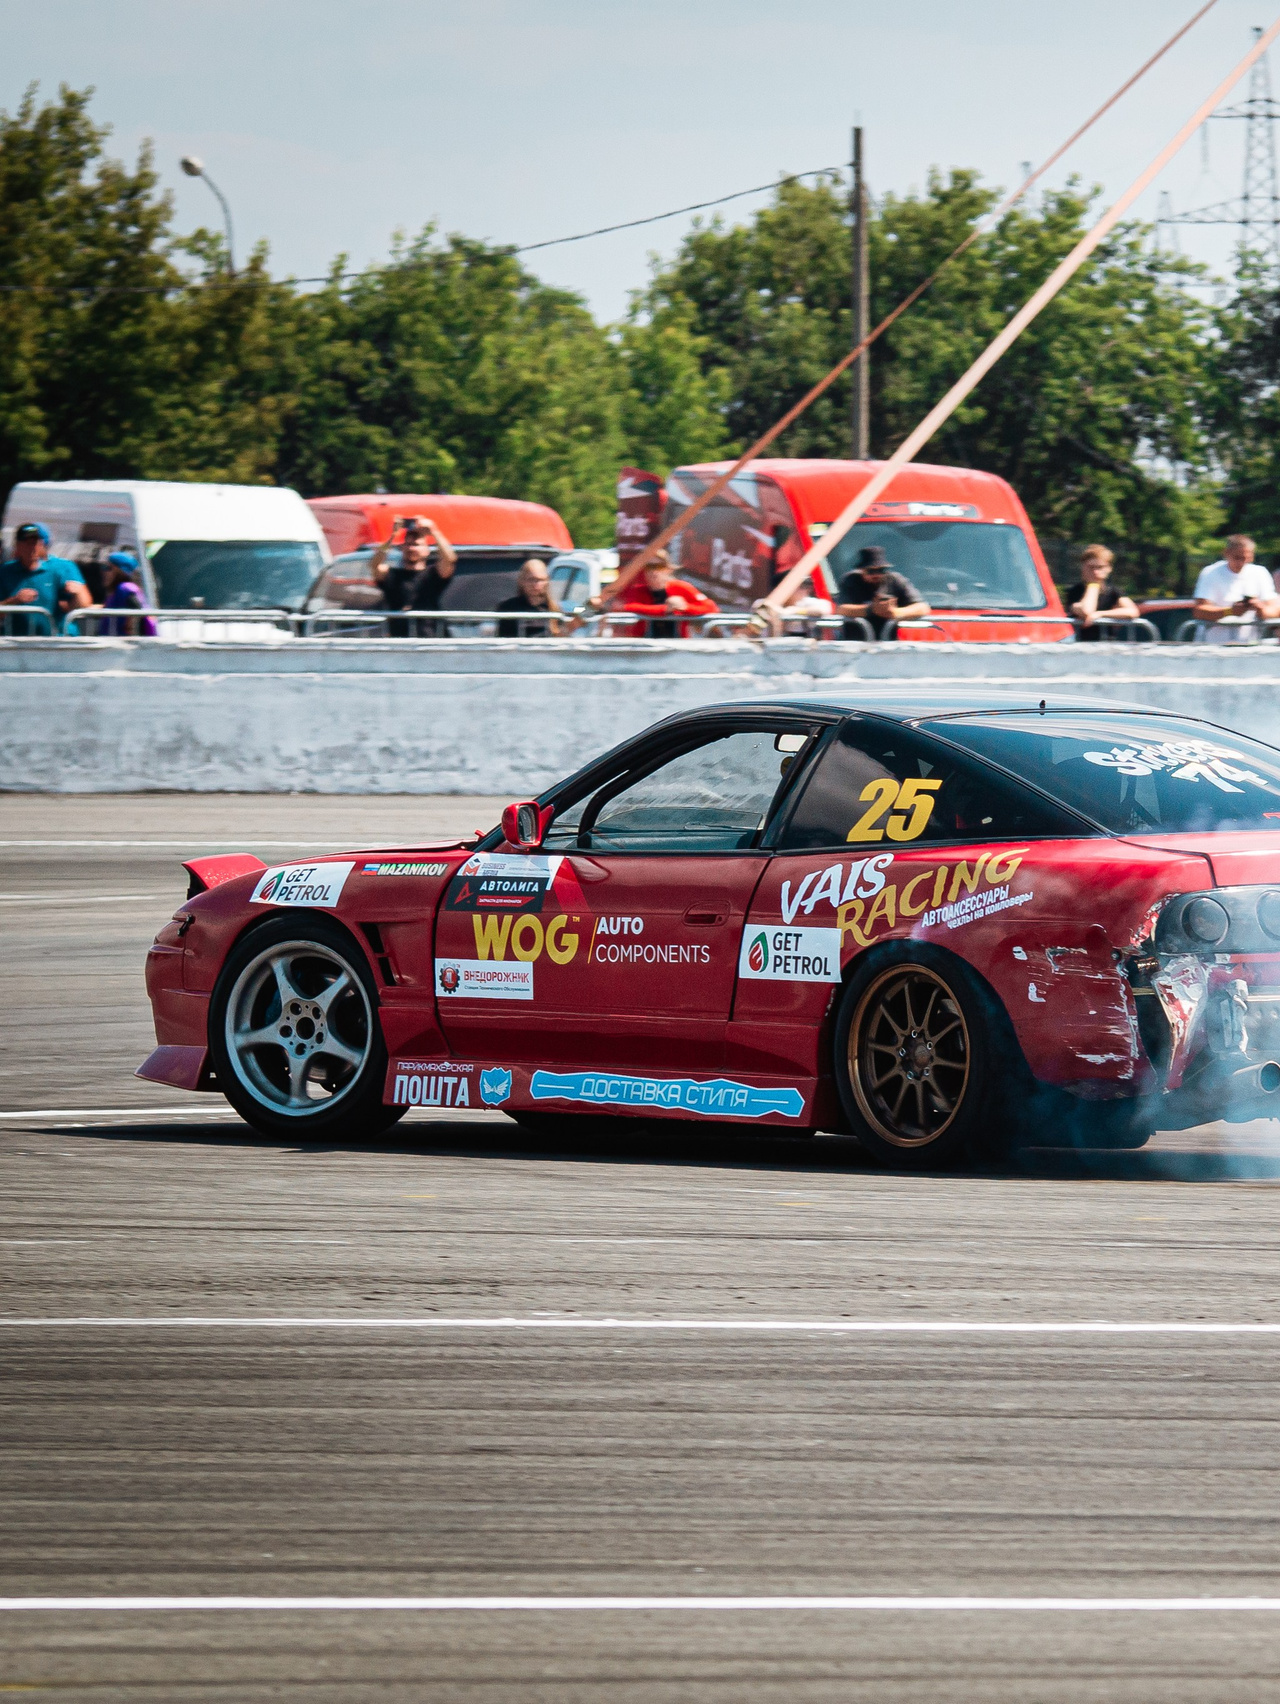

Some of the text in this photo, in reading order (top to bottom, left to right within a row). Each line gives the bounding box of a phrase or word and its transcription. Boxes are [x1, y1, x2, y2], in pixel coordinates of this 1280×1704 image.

[846, 778, 943, 842] 25
[286, 868, 317, 883] GET
[378, 863, 449, 877] MAZANIKOV
[276, 885, 331, 901] PETROL
[479, 880, 540, 892] АВТОЛИГА
[781, 853, 895, 924] VAIS
[836, 848, 1030, 948] RACING
[921, 884, 1010, 928] АВТОАКСЕССУАРЫ
[596, 917, 644, 935] AUTO
[472, 913, 580, 965] WOG
[772, 932, 803, 952] GET
[595, 944, 710, 964] COMPONENTS
[773, 955, 832, 976] PETROL
[464, 970, 530, 984] ВНЕДОРОЖНИК
[393, 1074, 470, 1106] ПОШТА
[579, 1078, 682, 1103] ДОСТАВКА
